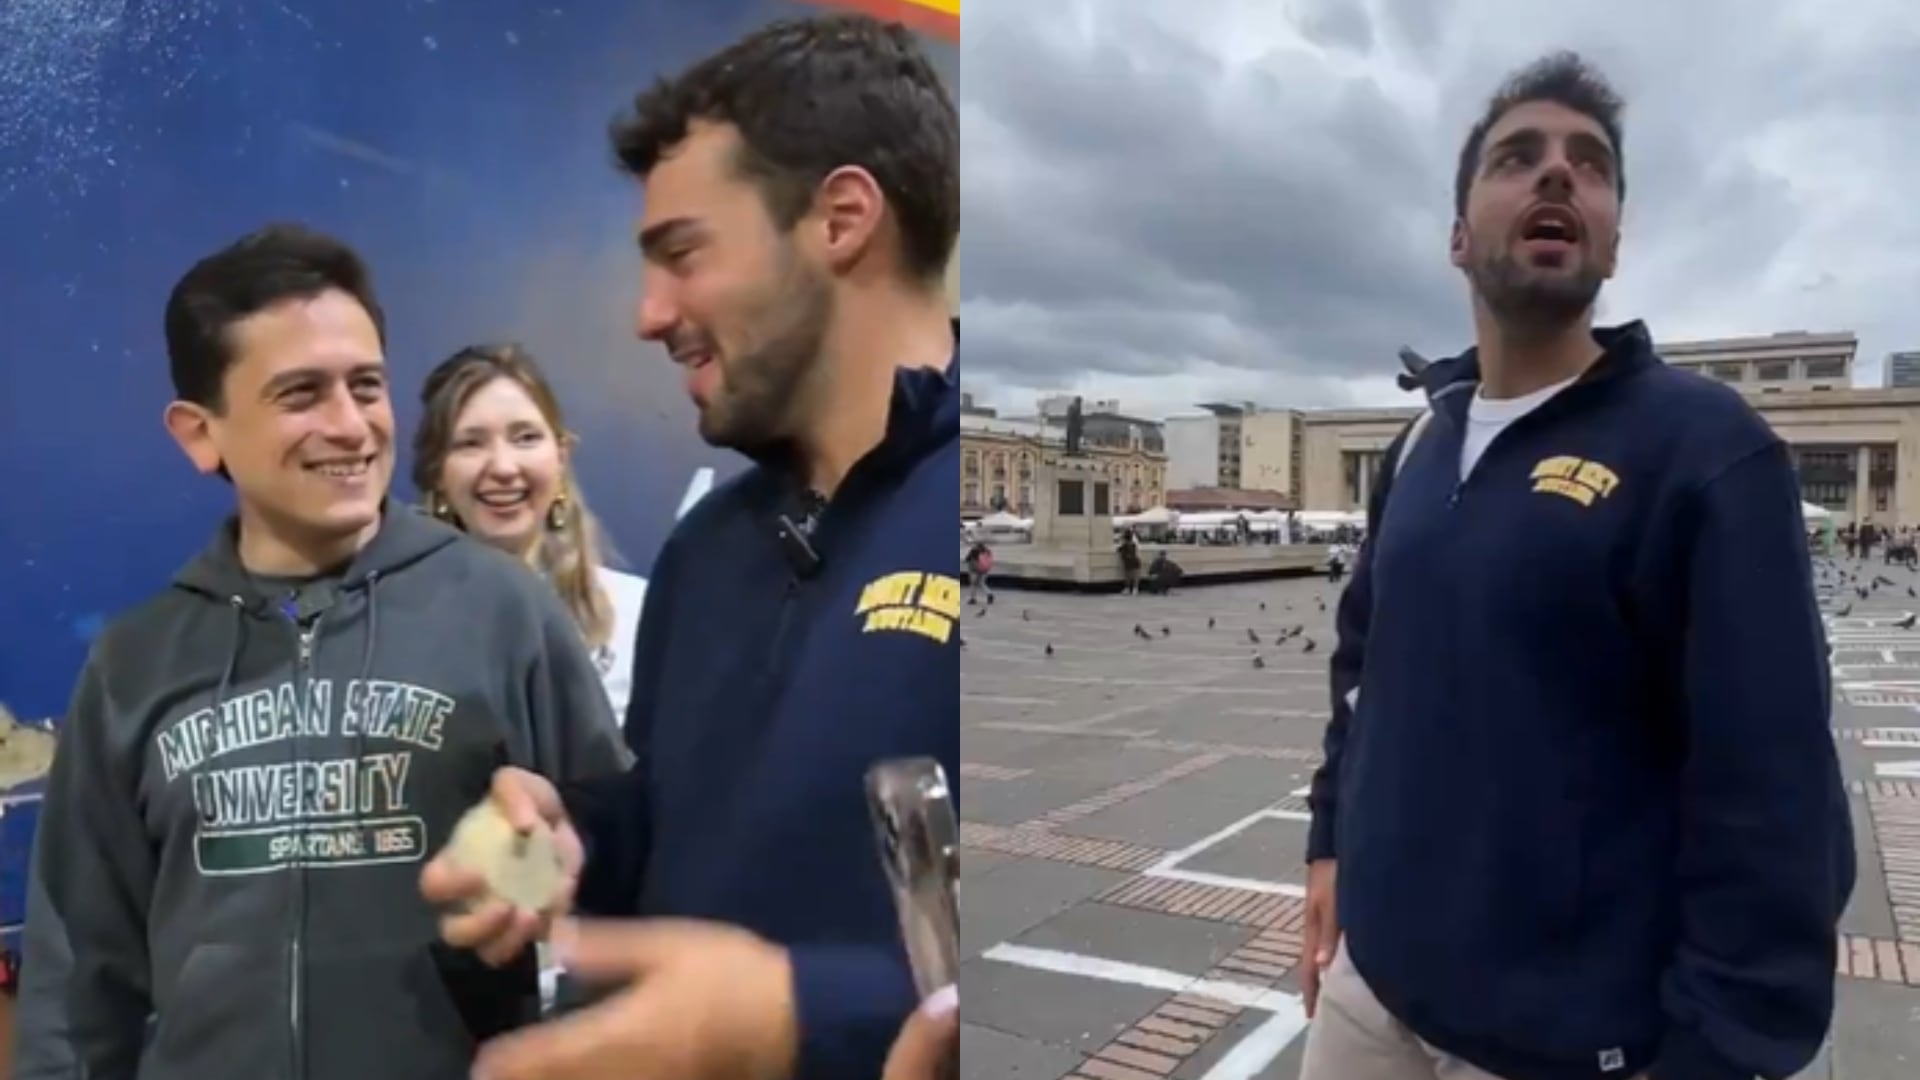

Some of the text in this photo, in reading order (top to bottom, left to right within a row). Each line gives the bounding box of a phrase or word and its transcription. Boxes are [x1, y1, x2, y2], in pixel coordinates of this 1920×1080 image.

[157, 679, 455, 782] MICHIGAN STATE
[192, 753, 411, 826] UNIVERSITY
